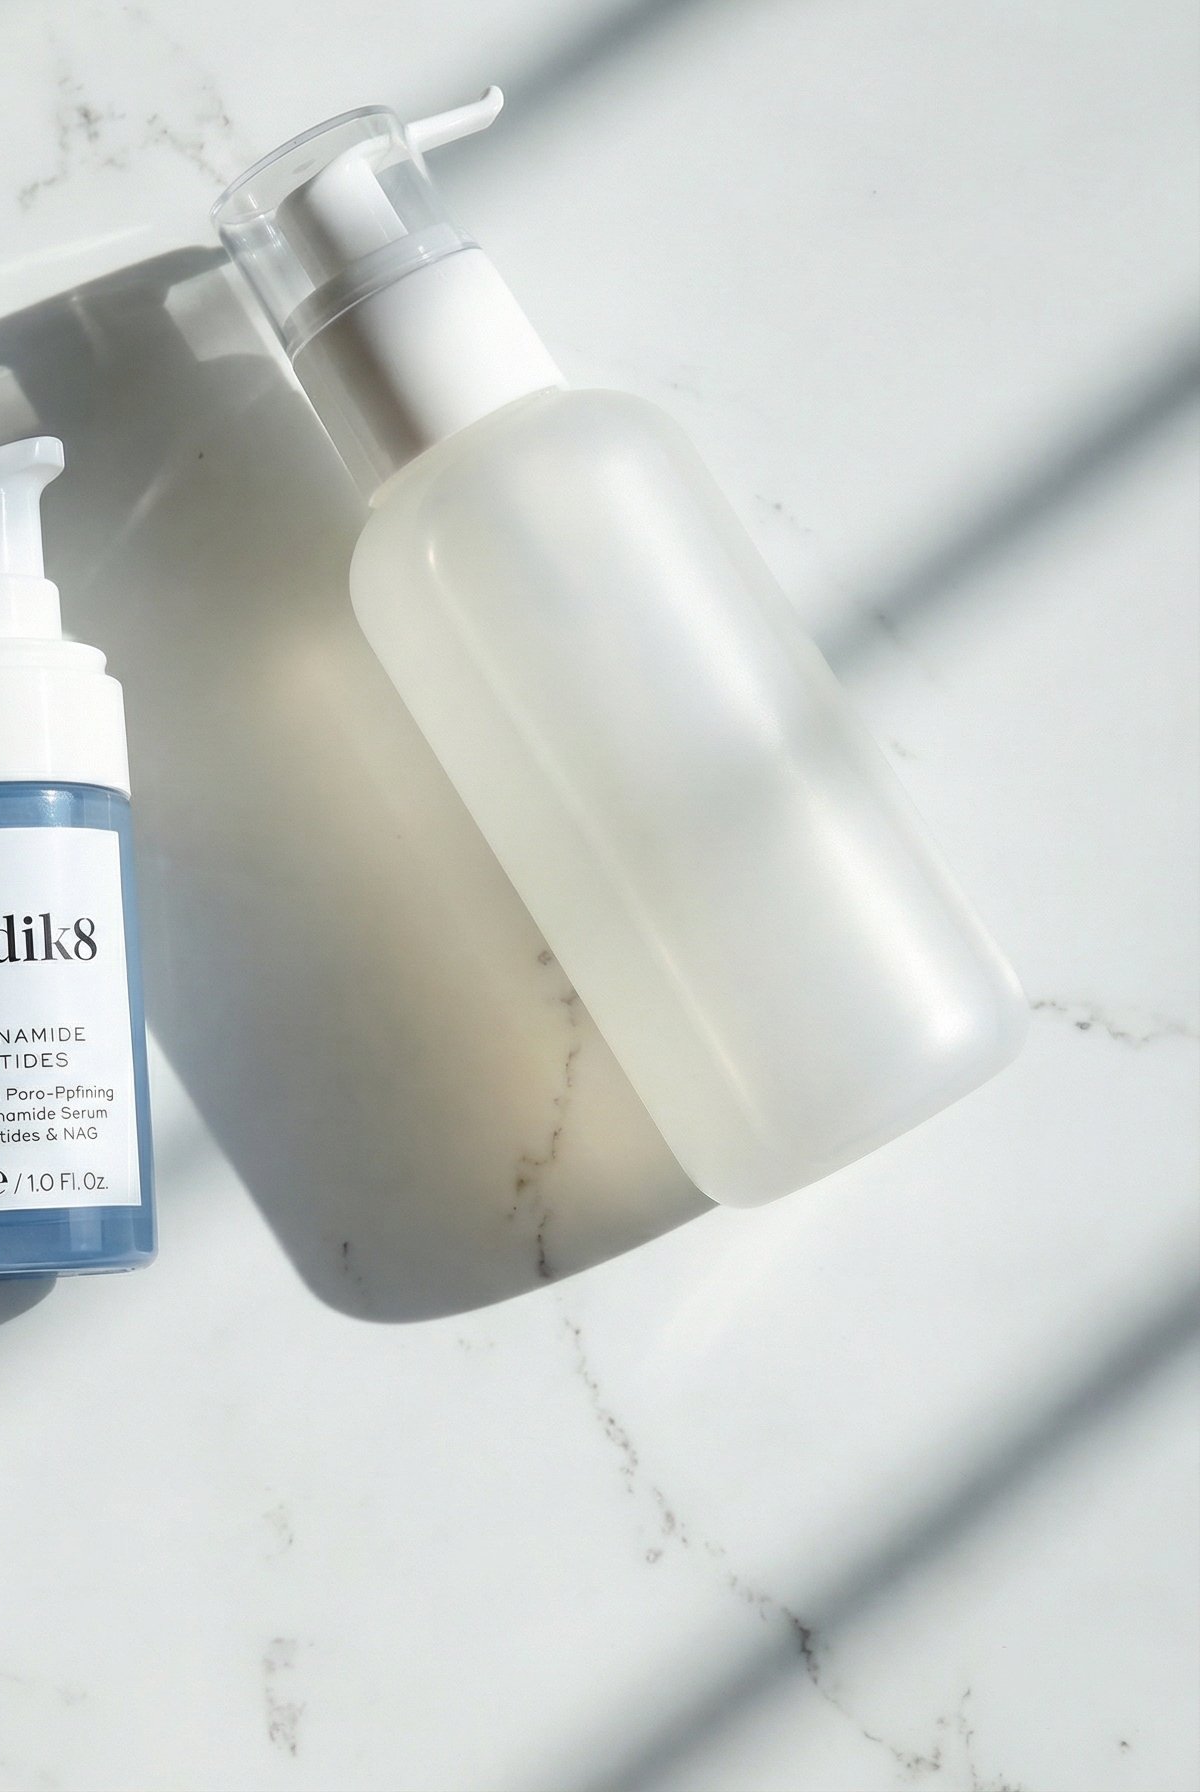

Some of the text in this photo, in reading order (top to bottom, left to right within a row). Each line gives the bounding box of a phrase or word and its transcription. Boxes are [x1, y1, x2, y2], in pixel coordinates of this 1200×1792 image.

[61, 1106, 108, 1120] Serum
[46, 1127, 58, 1142] &
[63, 1126, 98, 1141] NAG
